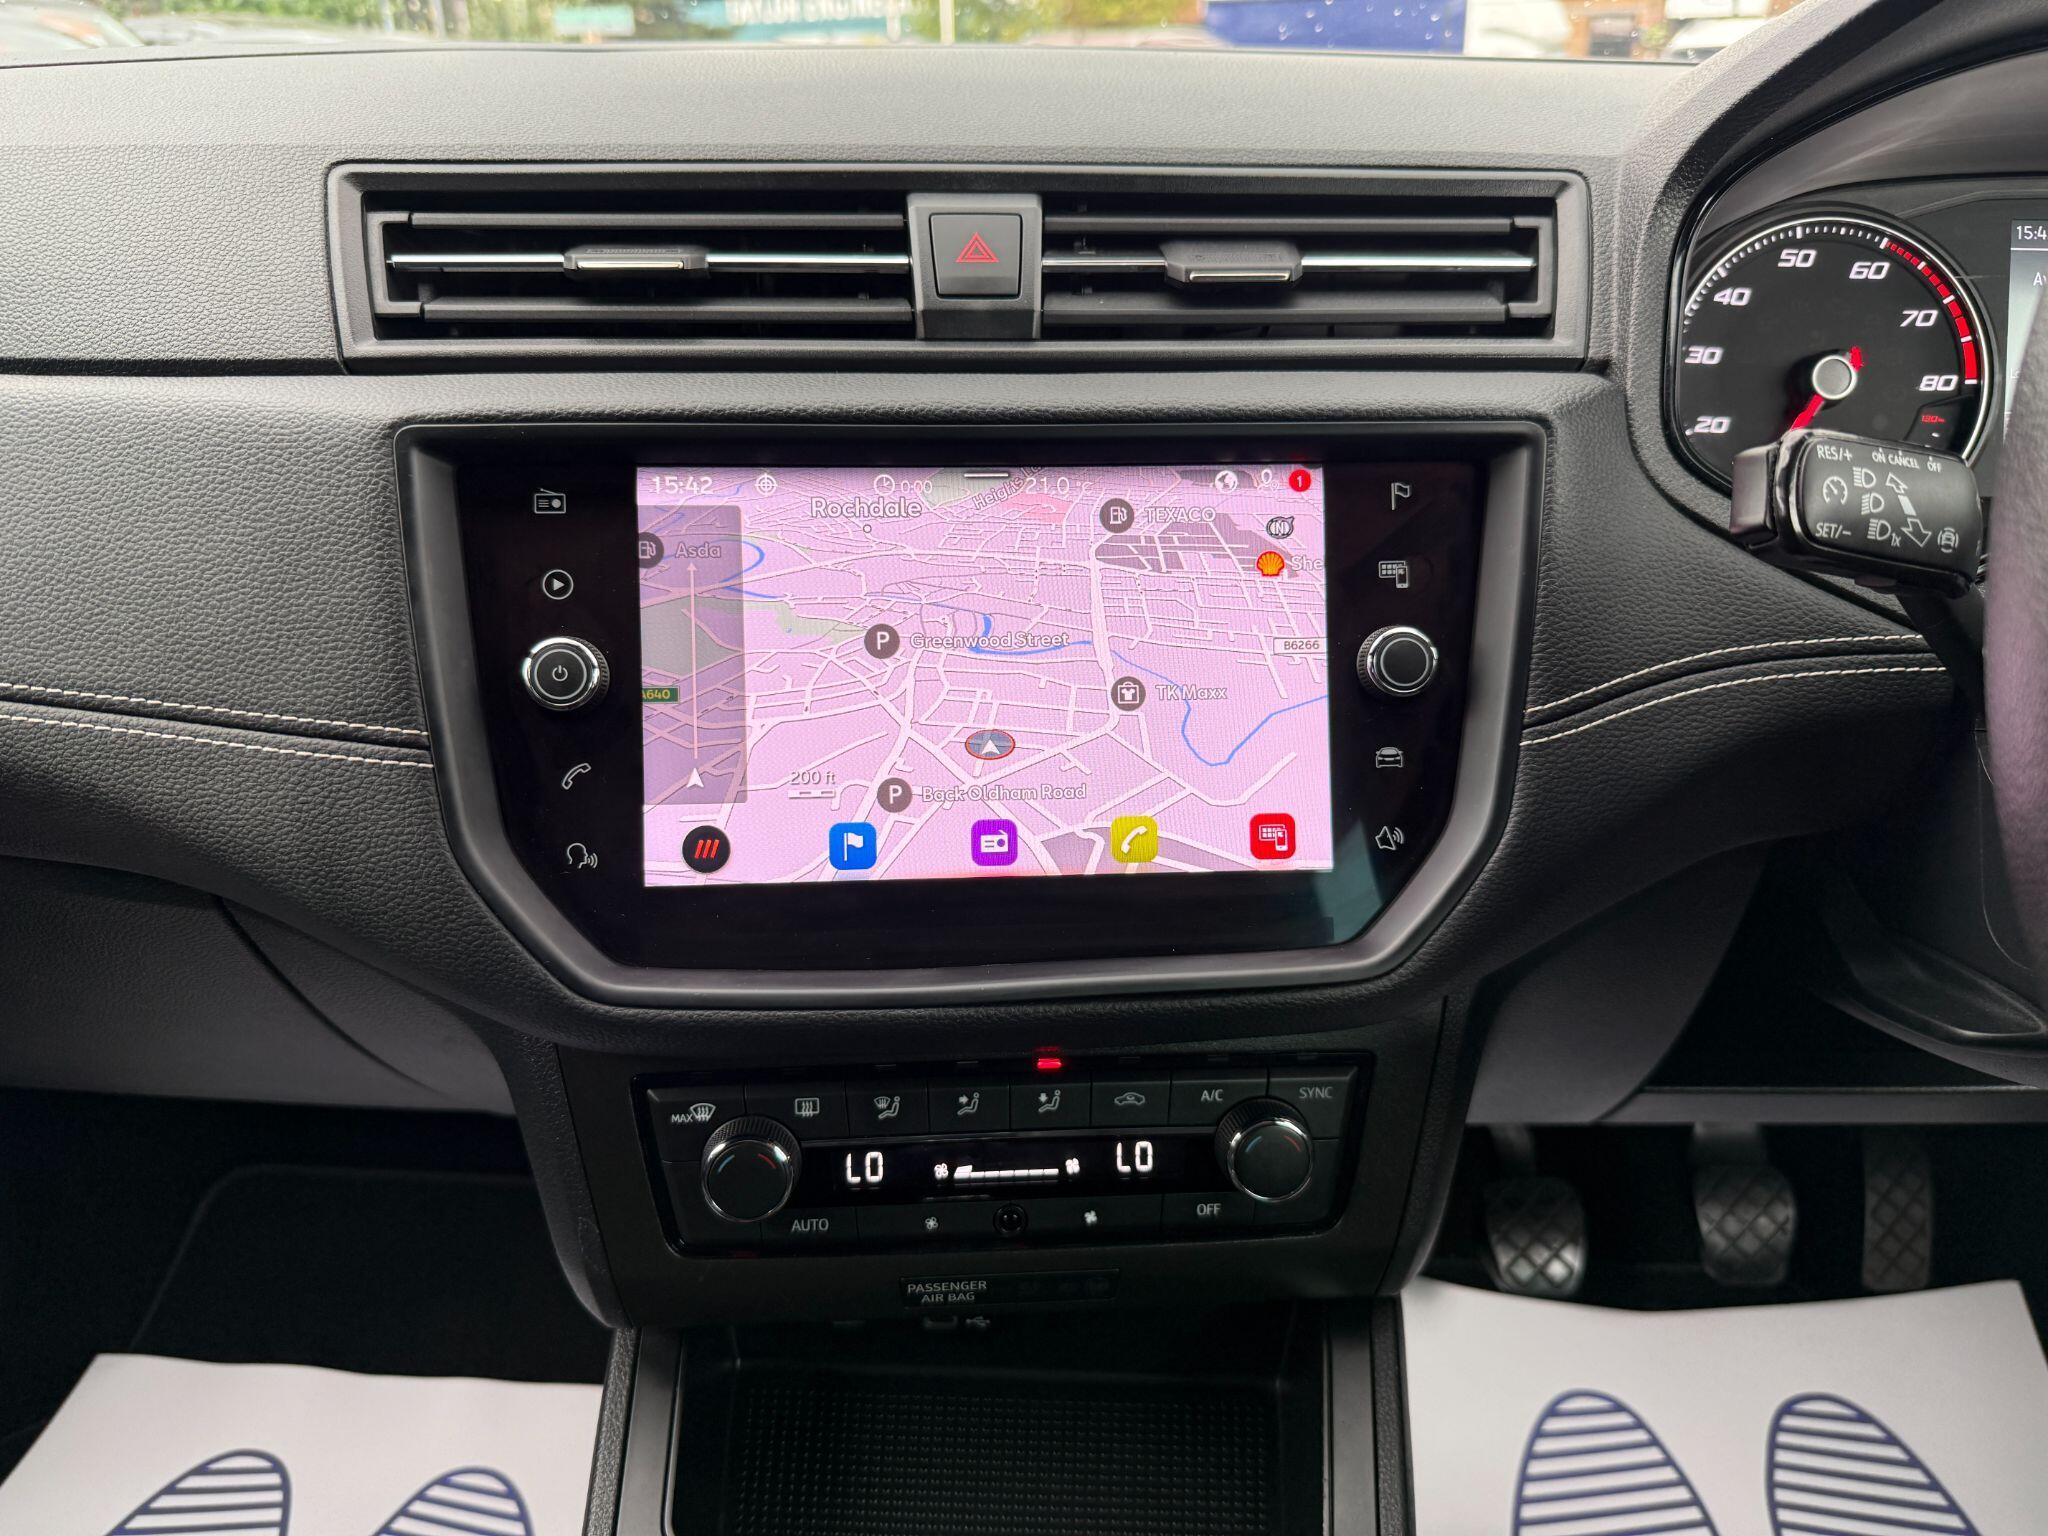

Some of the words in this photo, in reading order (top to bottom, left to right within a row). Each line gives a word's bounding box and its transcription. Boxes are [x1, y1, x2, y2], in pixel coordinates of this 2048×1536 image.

[1777, 248, 1818, 269] 50
[1849, 260, 1890, 280] 60
[1713, 286, 1752, 307] 40
[1900, 309, 1938, 328] 70
[1684, 346, 1724, 365] 30
[1918, 375, 1958, 392] 80
[1693, 415, 1732, 434] 20
[1871, 450, 1887, 464] ON
[1887, 452, 1920, 470] CANCEL
[1926, 459, 1942, 473] OFF
[651, 475, 714, 495] 15:42
[900, 480, 933, 494] 0:00
[971, 476, 1025, 511] Heights
[1026, 476, 1070, 495] 21.0
[810, 496, 923, 519] Rochdale
[1144, 506, 1217, 523] TEXACO
[675, 542, 722, 559] Asda
[910, 632, 1014, 650] Greenwood
[1015, 632, 1069, 648] Street
[1283, 638, 1320, 651] B6266
[1155, 684, 1180, 700] TK
[1181, 684, 1228, 700] Maxx
[790, 771, 821, 785] 200
[825, 770, 836, 785] ft
[922, 784, 965, 802] Back
[968, 783, 1037, 801] Oldham
[1040, 783, 1087, 800] Road
[1201, 1088, 1224, 1102] A/C
[1299, 1086, 1334, 1099] SYNC
[671, 1113, 694, 1123] MAX
[1196, 1203, 1222, 1217] OFF
[791, 1218, 830, 1233] AUTO
[907, 1279, 987, 1294] PASSENGER
[920, 1292, 944, 1303] AIR
[947, 1290, 976, 1303] BAG
